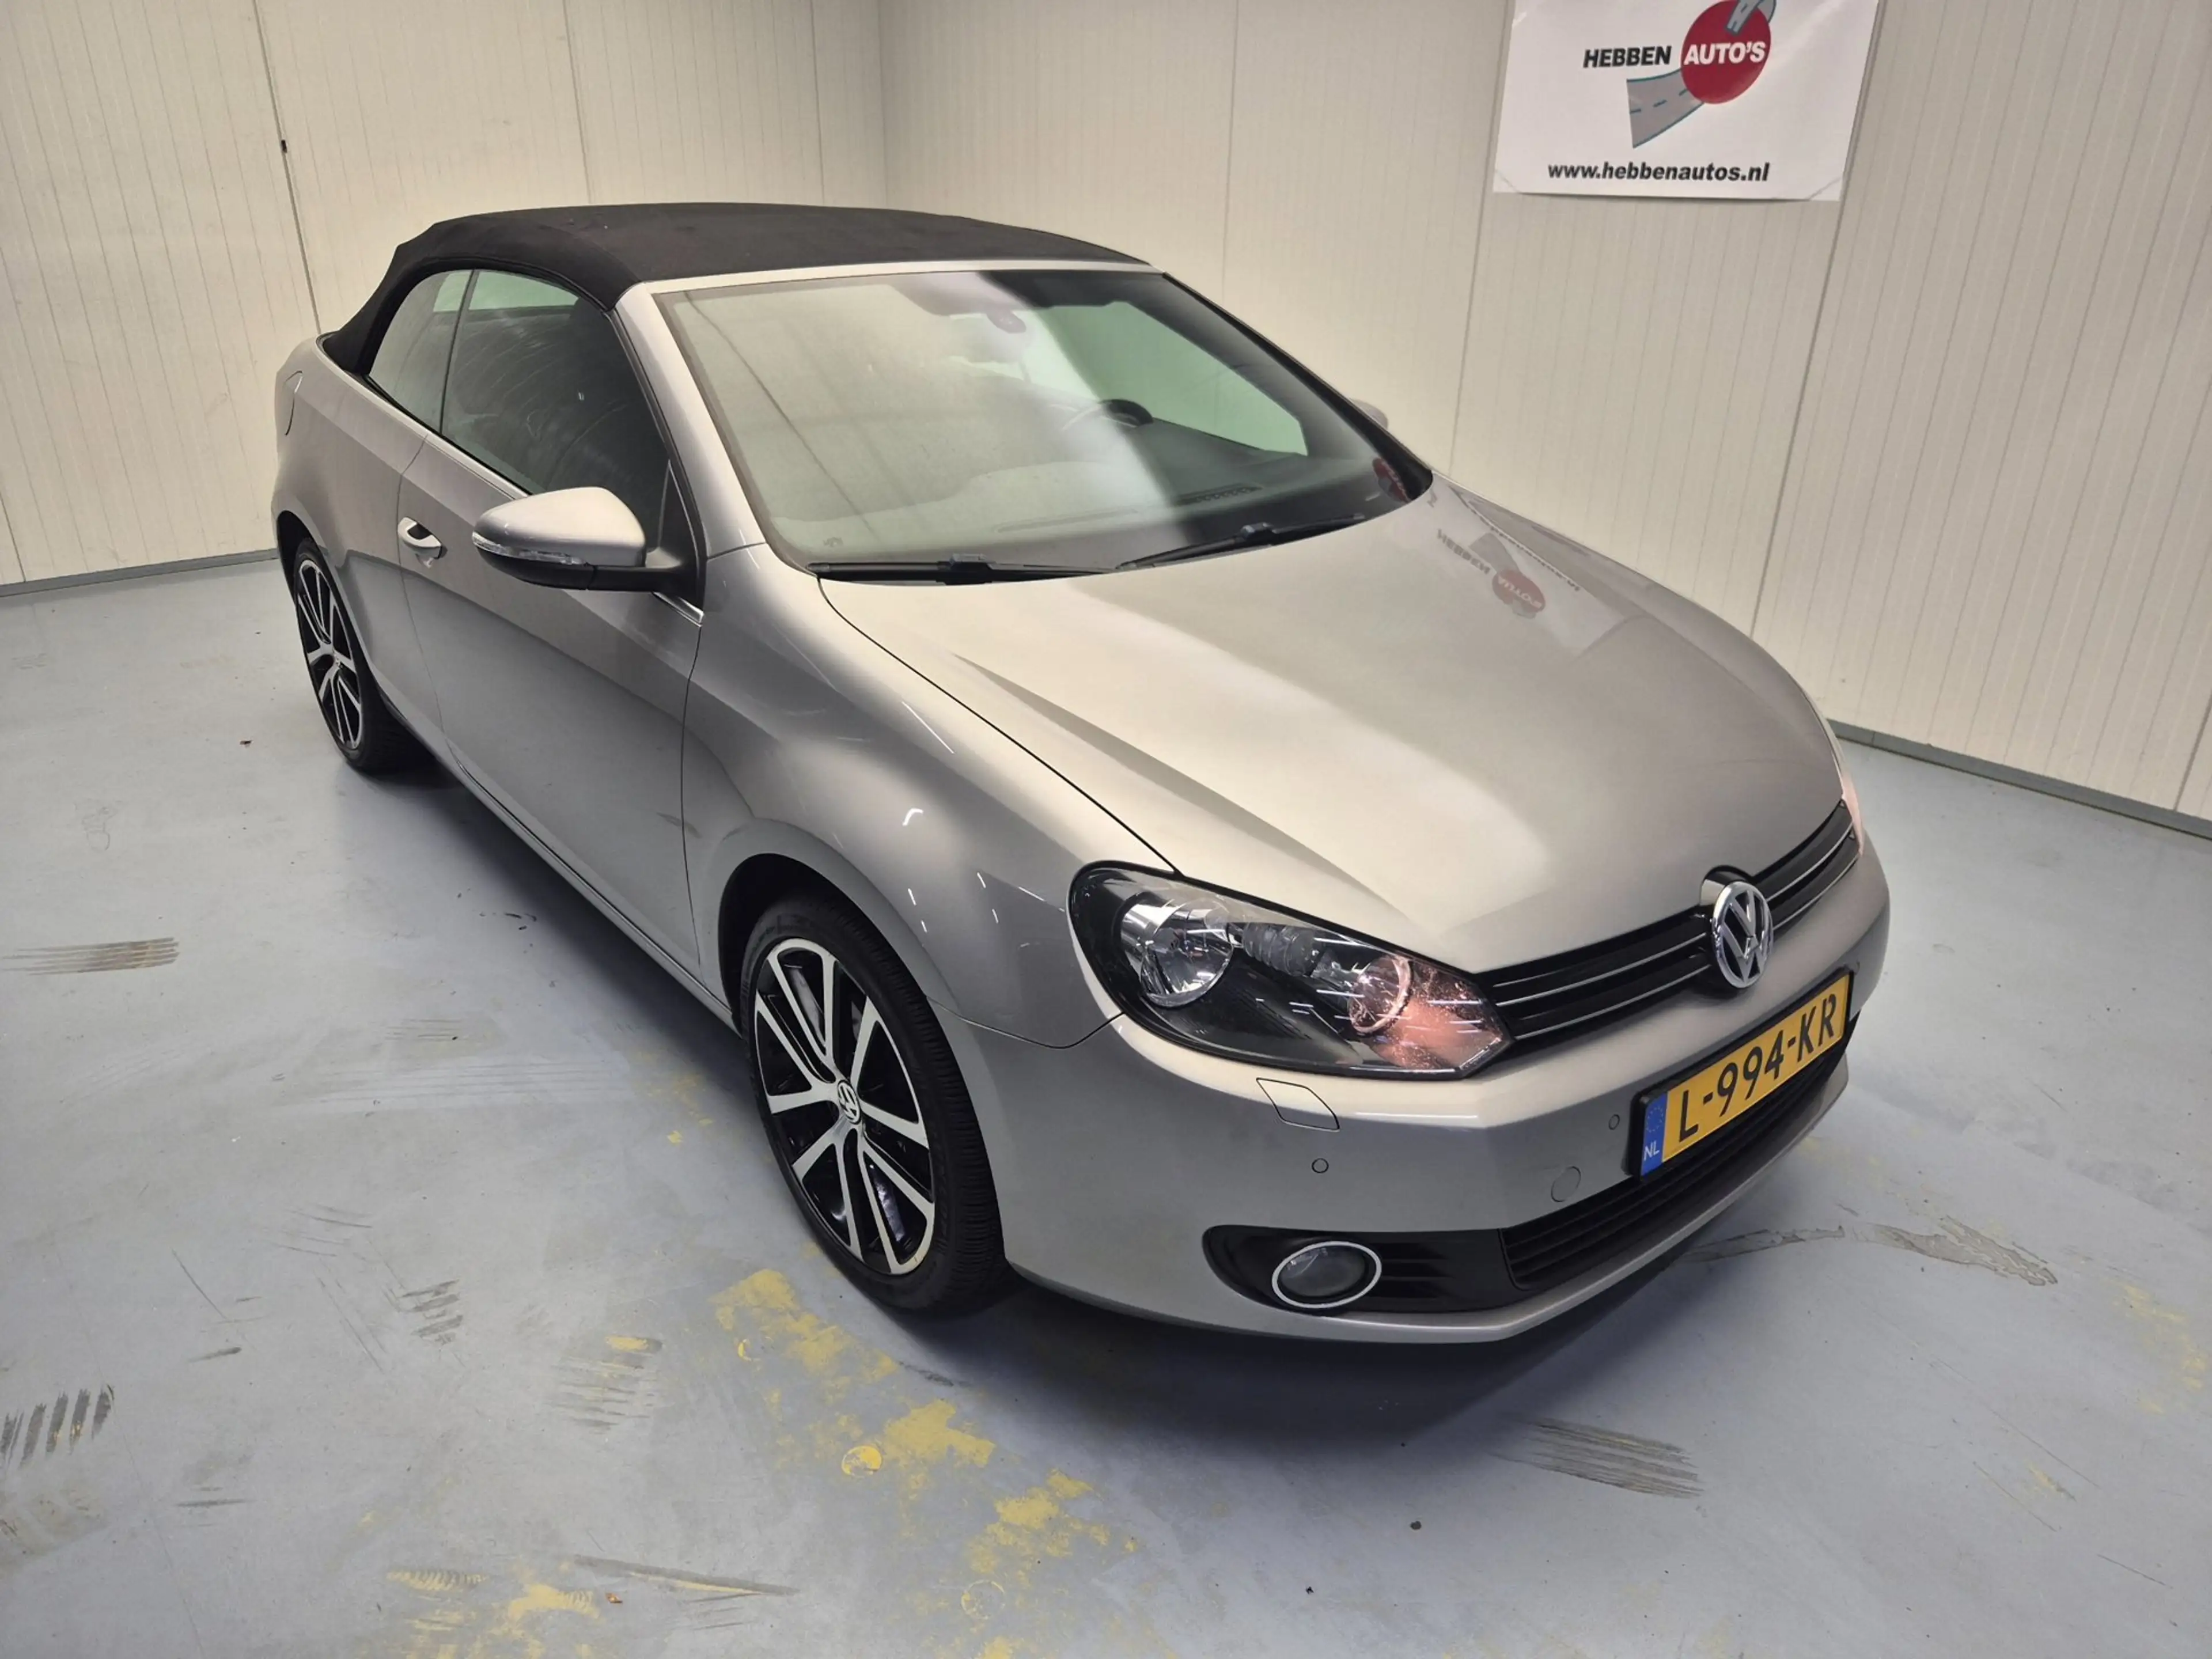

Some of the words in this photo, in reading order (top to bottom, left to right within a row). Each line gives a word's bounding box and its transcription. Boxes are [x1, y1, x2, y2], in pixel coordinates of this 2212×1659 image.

[1582, 46, 1672, 69] HEBBEN
[1683, 41, 1767, 66] AUTO'S
[1547, 161, 1771, 182] www.hebbenautos.nl
[1679, 993, 1837, 1143] L-994-KR
[1643, 1140, 1660, 1162] NL
